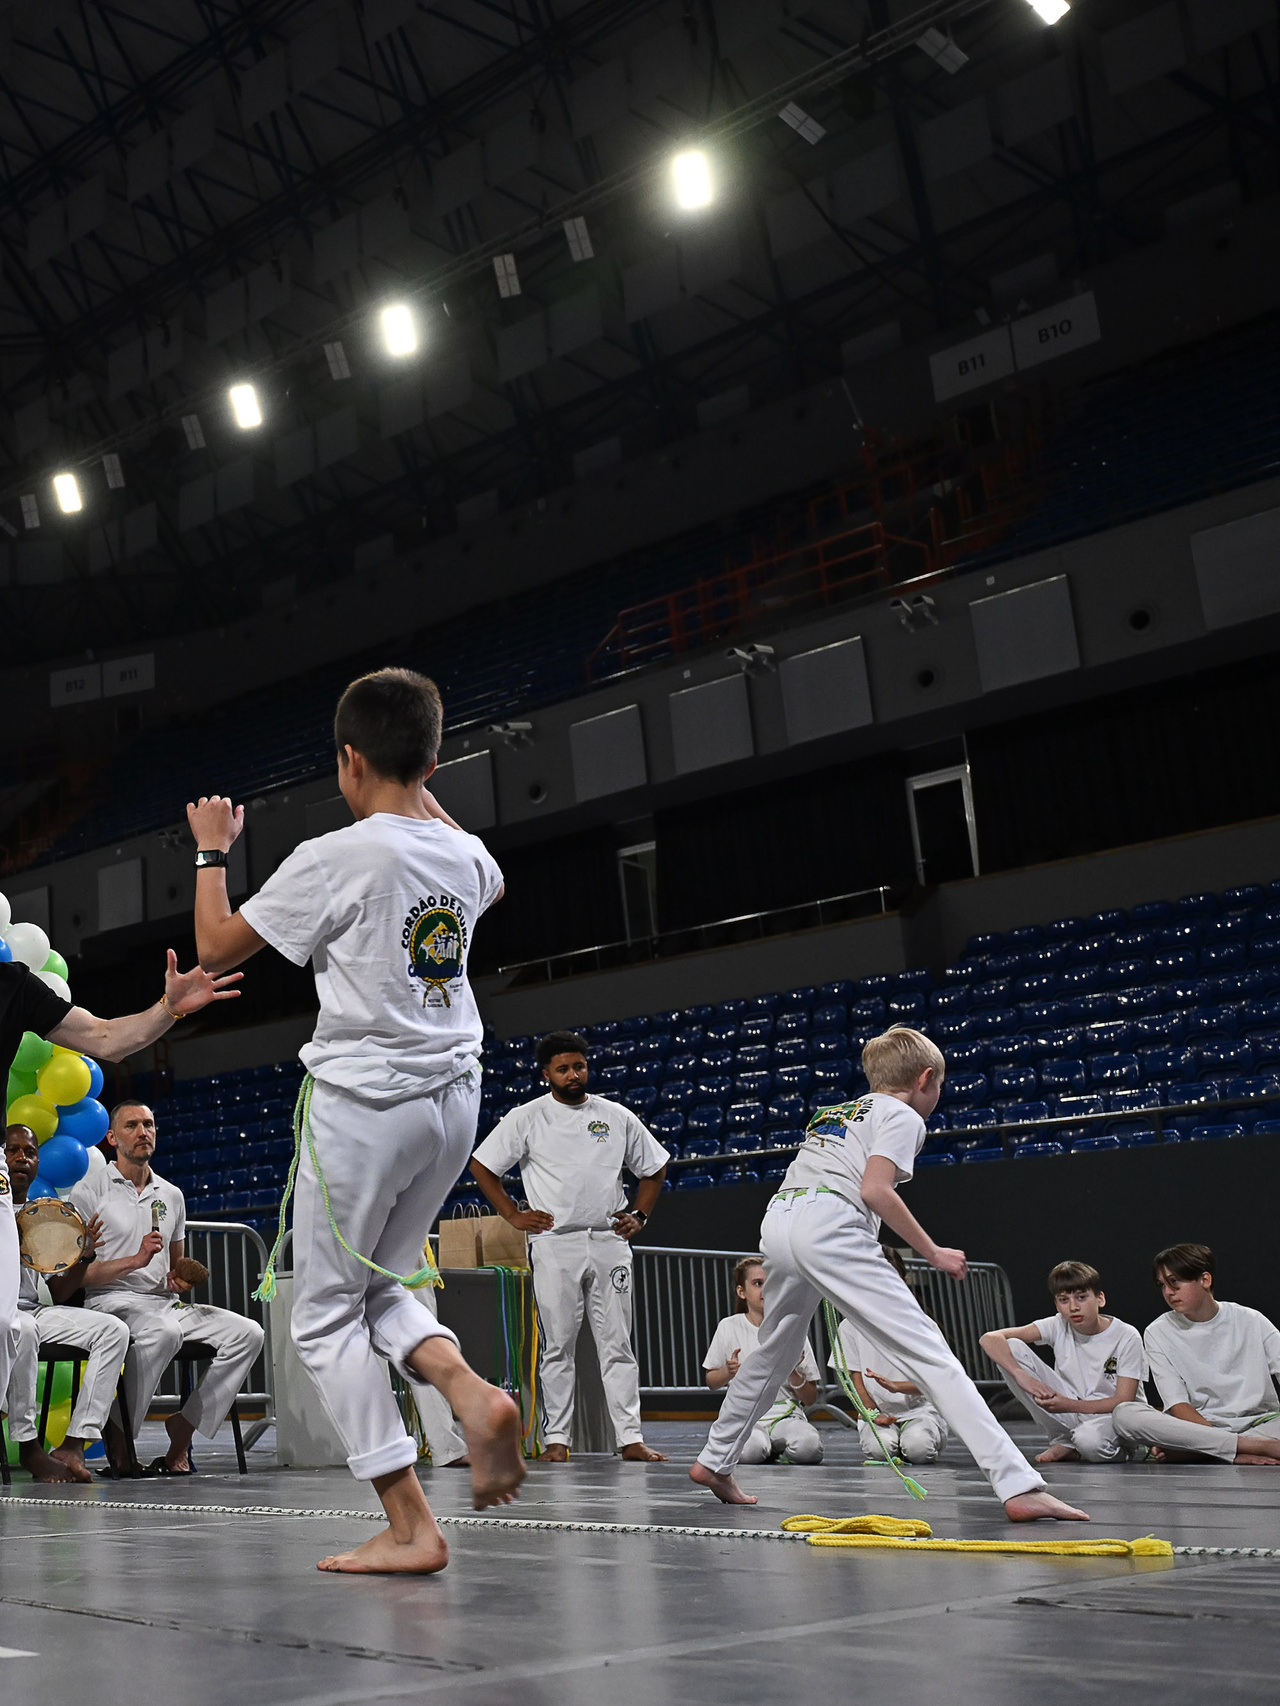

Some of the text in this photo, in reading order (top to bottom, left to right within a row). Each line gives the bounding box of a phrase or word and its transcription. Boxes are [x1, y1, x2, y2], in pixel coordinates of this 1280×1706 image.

[1038, 319, 1072, 344] B10
[958, 353, 985, 376] B11
[120, 669, 138, 682] B11
[401, 894, 468, 950] CORDÃO DE OURO
